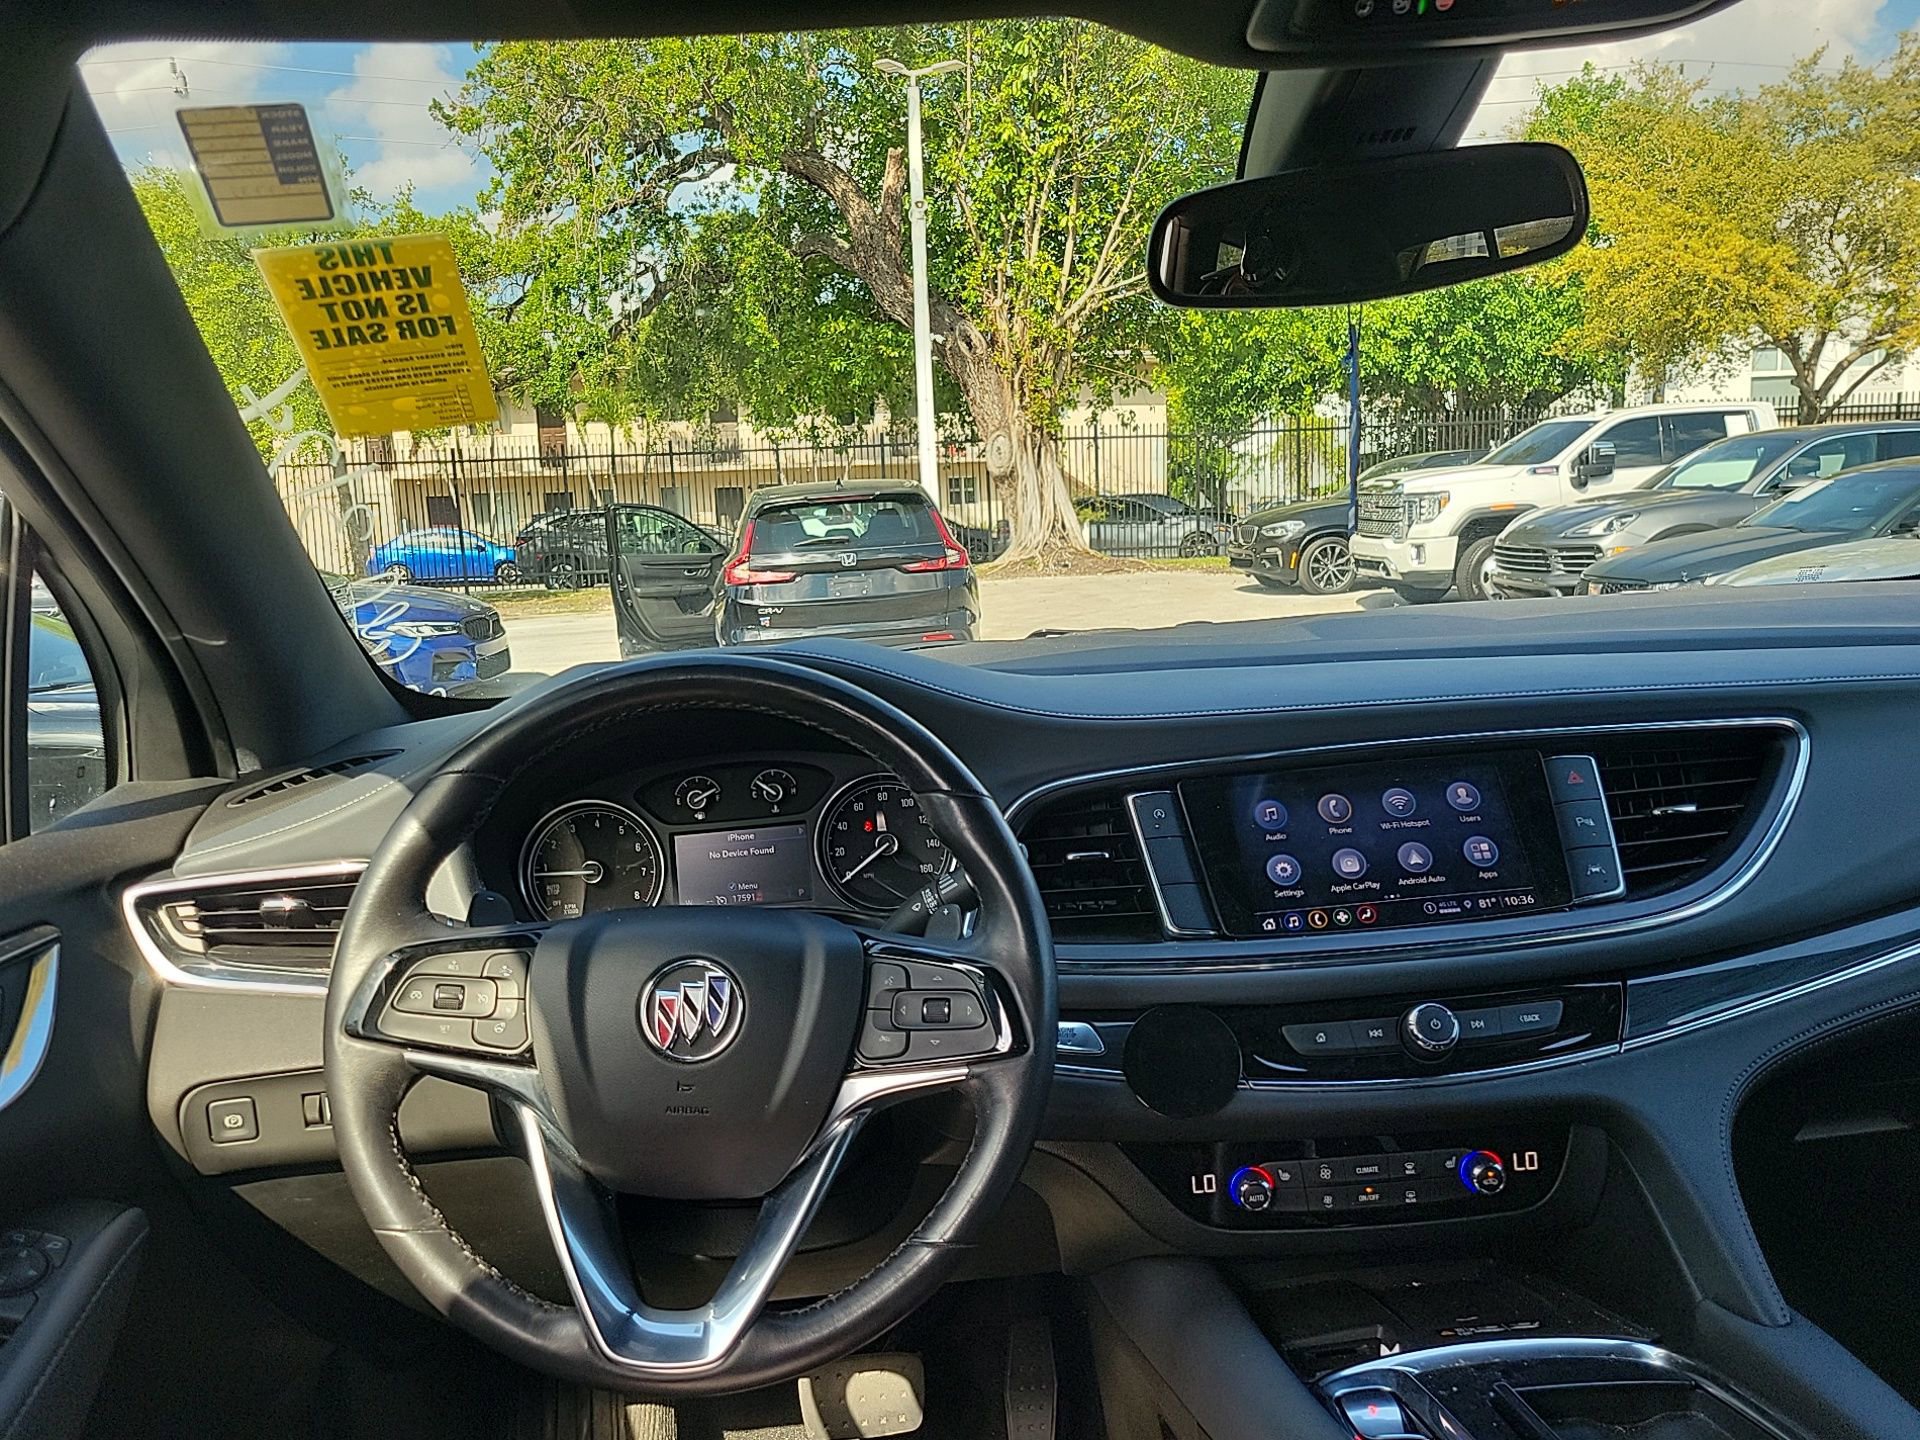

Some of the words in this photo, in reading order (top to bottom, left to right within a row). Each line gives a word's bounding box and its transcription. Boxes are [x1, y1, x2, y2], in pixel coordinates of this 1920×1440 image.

[877, 792, 888, 801] 80
[853, 802, 864, 812] 60
[901, 798, 914, 807] 100
[918, 815, 928, 824] 12
[1459, 815, 1482, 823] Users
[837, 821, 848, 830] 40
[1380, 822, 1400, 830] Wi-Fi
[1401, 819, 1431, 828] Hotspot
[1328, 827, 1352, 835] Phone
[727, 832, 755, 842] iPhone
[1265, 833, 1287, 841] Audio
[926, 839, 940, 848] 140
[709, 851, 721, 859] No
[722, 848, 749, 858] Device
[750, 845, 775, 855] Found
[835, 847, 845, 857] 20
[920, 863, 934, 873] 160
[1478, 871, 1499, 879] Apps
[1398, 876, 1427, 886] Android
[1428, 875, 1446, 883] Auto
[738, 883, 758, 891] Menu
[1330, 884, 1352, 893] Apple
[1353, 881, 1381, 891] CarPlay
[1274, 889, 1305, 898] Settings
[732, 893, 756, 904] 17591
[1504, 894, 1535, 907] 10:36
[665, 1105, 710, 1115] AIRBAG
[1513, 1151, 1538, 1171] LO
[1356, 1165, 1379, 1174] CLIMATE
[1192, 1174, 1217, 1194] LO
[1249, 1194, 1265, 1202] AUTO
[1358, 1194, 1380, 1202] ON/OFF
